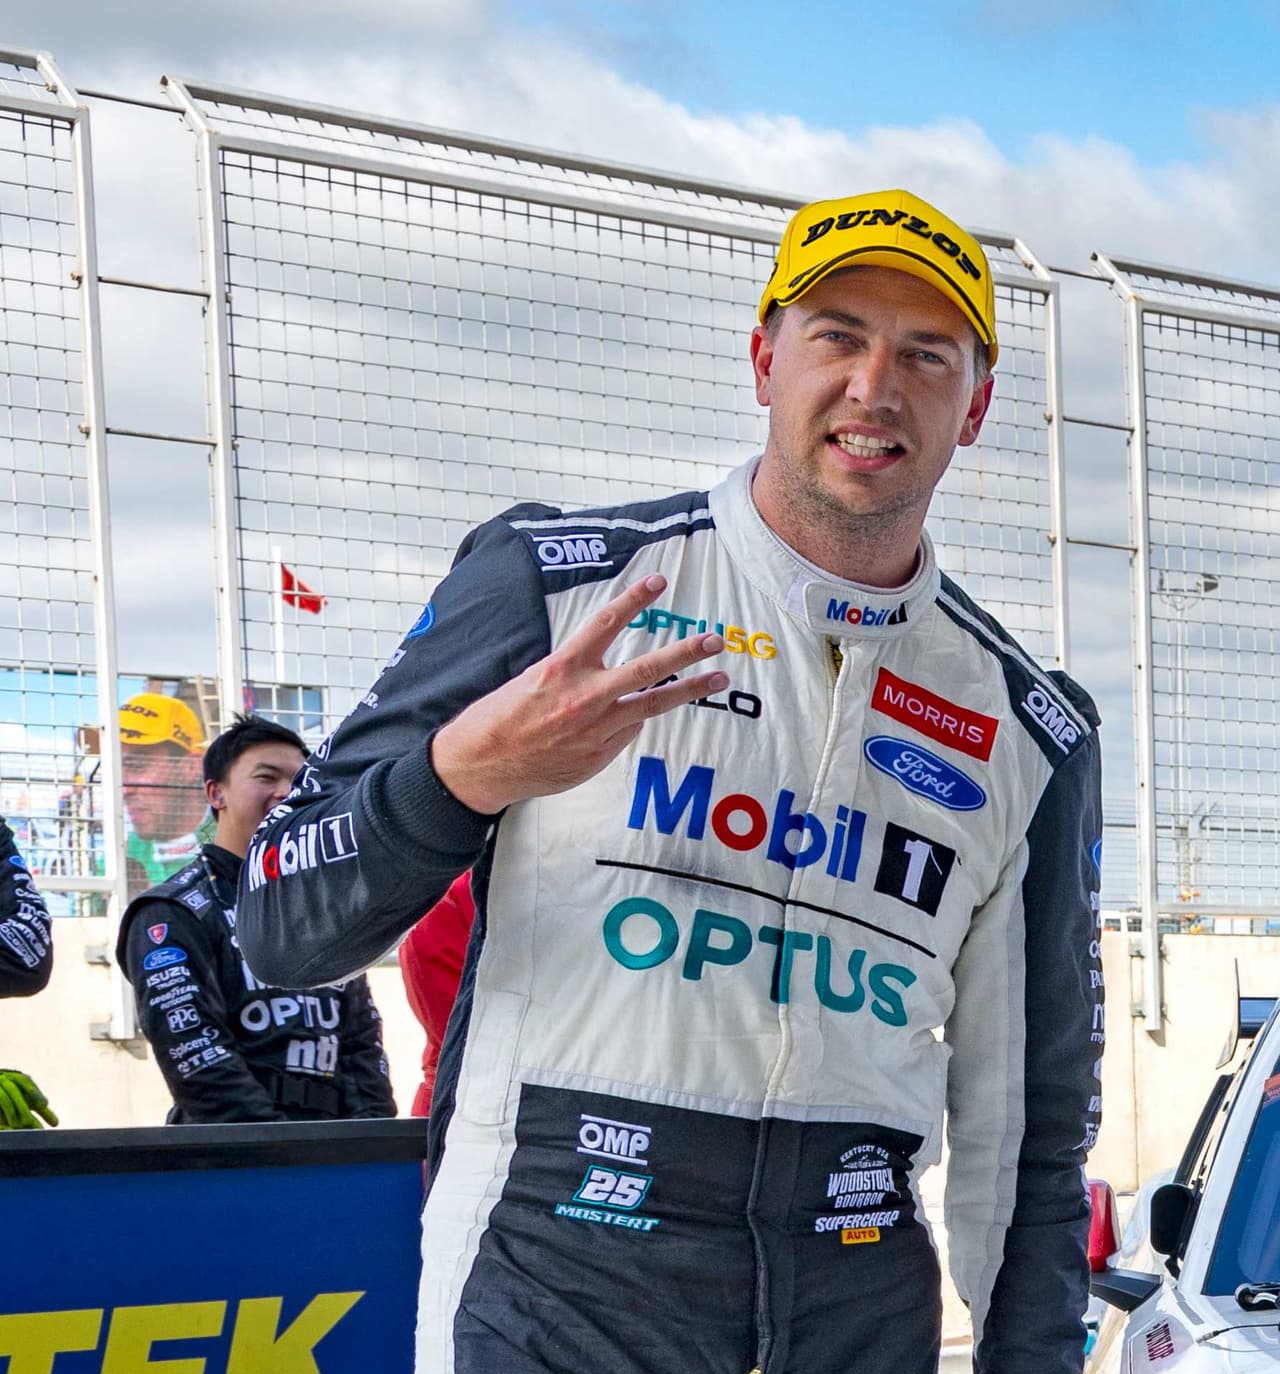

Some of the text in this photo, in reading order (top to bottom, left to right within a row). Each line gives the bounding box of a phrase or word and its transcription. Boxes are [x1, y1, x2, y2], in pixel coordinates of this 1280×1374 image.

[801, 208, 981, 281] DUNLOP
[538, 539, 608, 567] OMP
[826, 598, 889, 626] Mobil
[882, 684, 984, 745] MORRIS
[1026, 689, 1078, 746] OMP
[892, 750, 956, 799] Ford
[626, 756, 868, 883] Mobil
[248, 822, 319, 893] Mobil
[602, 897, 919, 1028] OPTUS
[168, 1008, 197, 1029] PPG
[240, 994, 340, 1032] OPTU
[579, 1122, 650, 1158] OMP
[577, 1168, 649, 1207] 25
[826, 1168, 896, 1198] WOODSTOCK
[834, 1192, 885, 1209] BOURBON
[814, 1210, 900, 1233] SUPERCHEAP
[846, 1230, 876, 1241] AUTO
